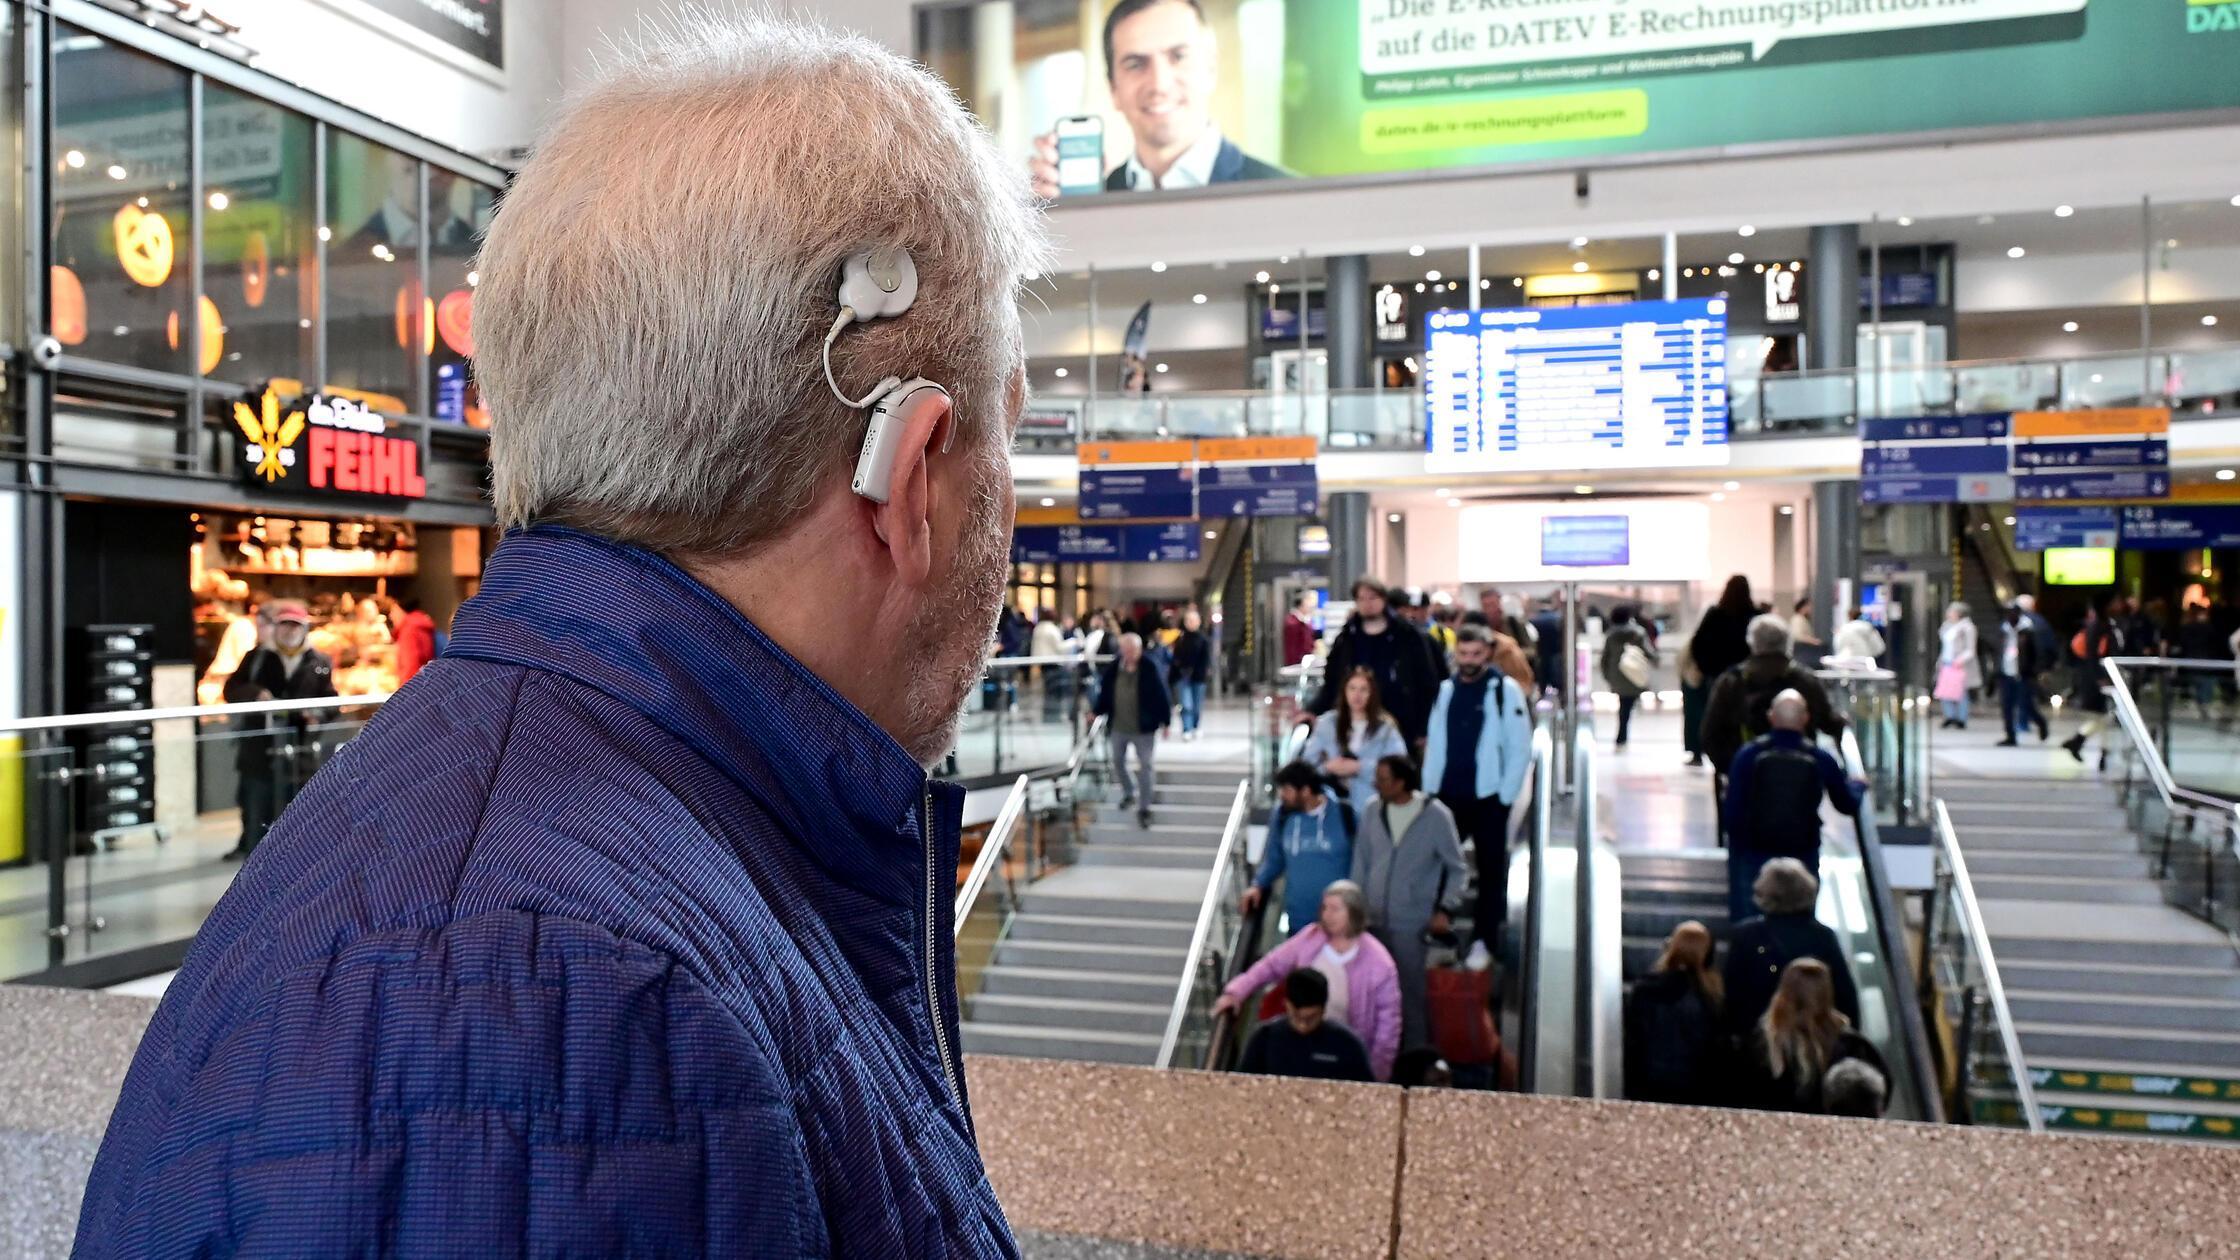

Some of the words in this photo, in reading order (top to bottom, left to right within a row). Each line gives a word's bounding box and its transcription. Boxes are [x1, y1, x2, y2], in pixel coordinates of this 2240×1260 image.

[1377, 29, 1422, 57] auf
[1431, 27, 1475, 53] die
[1488, 15, 1596, 48] DATEV
